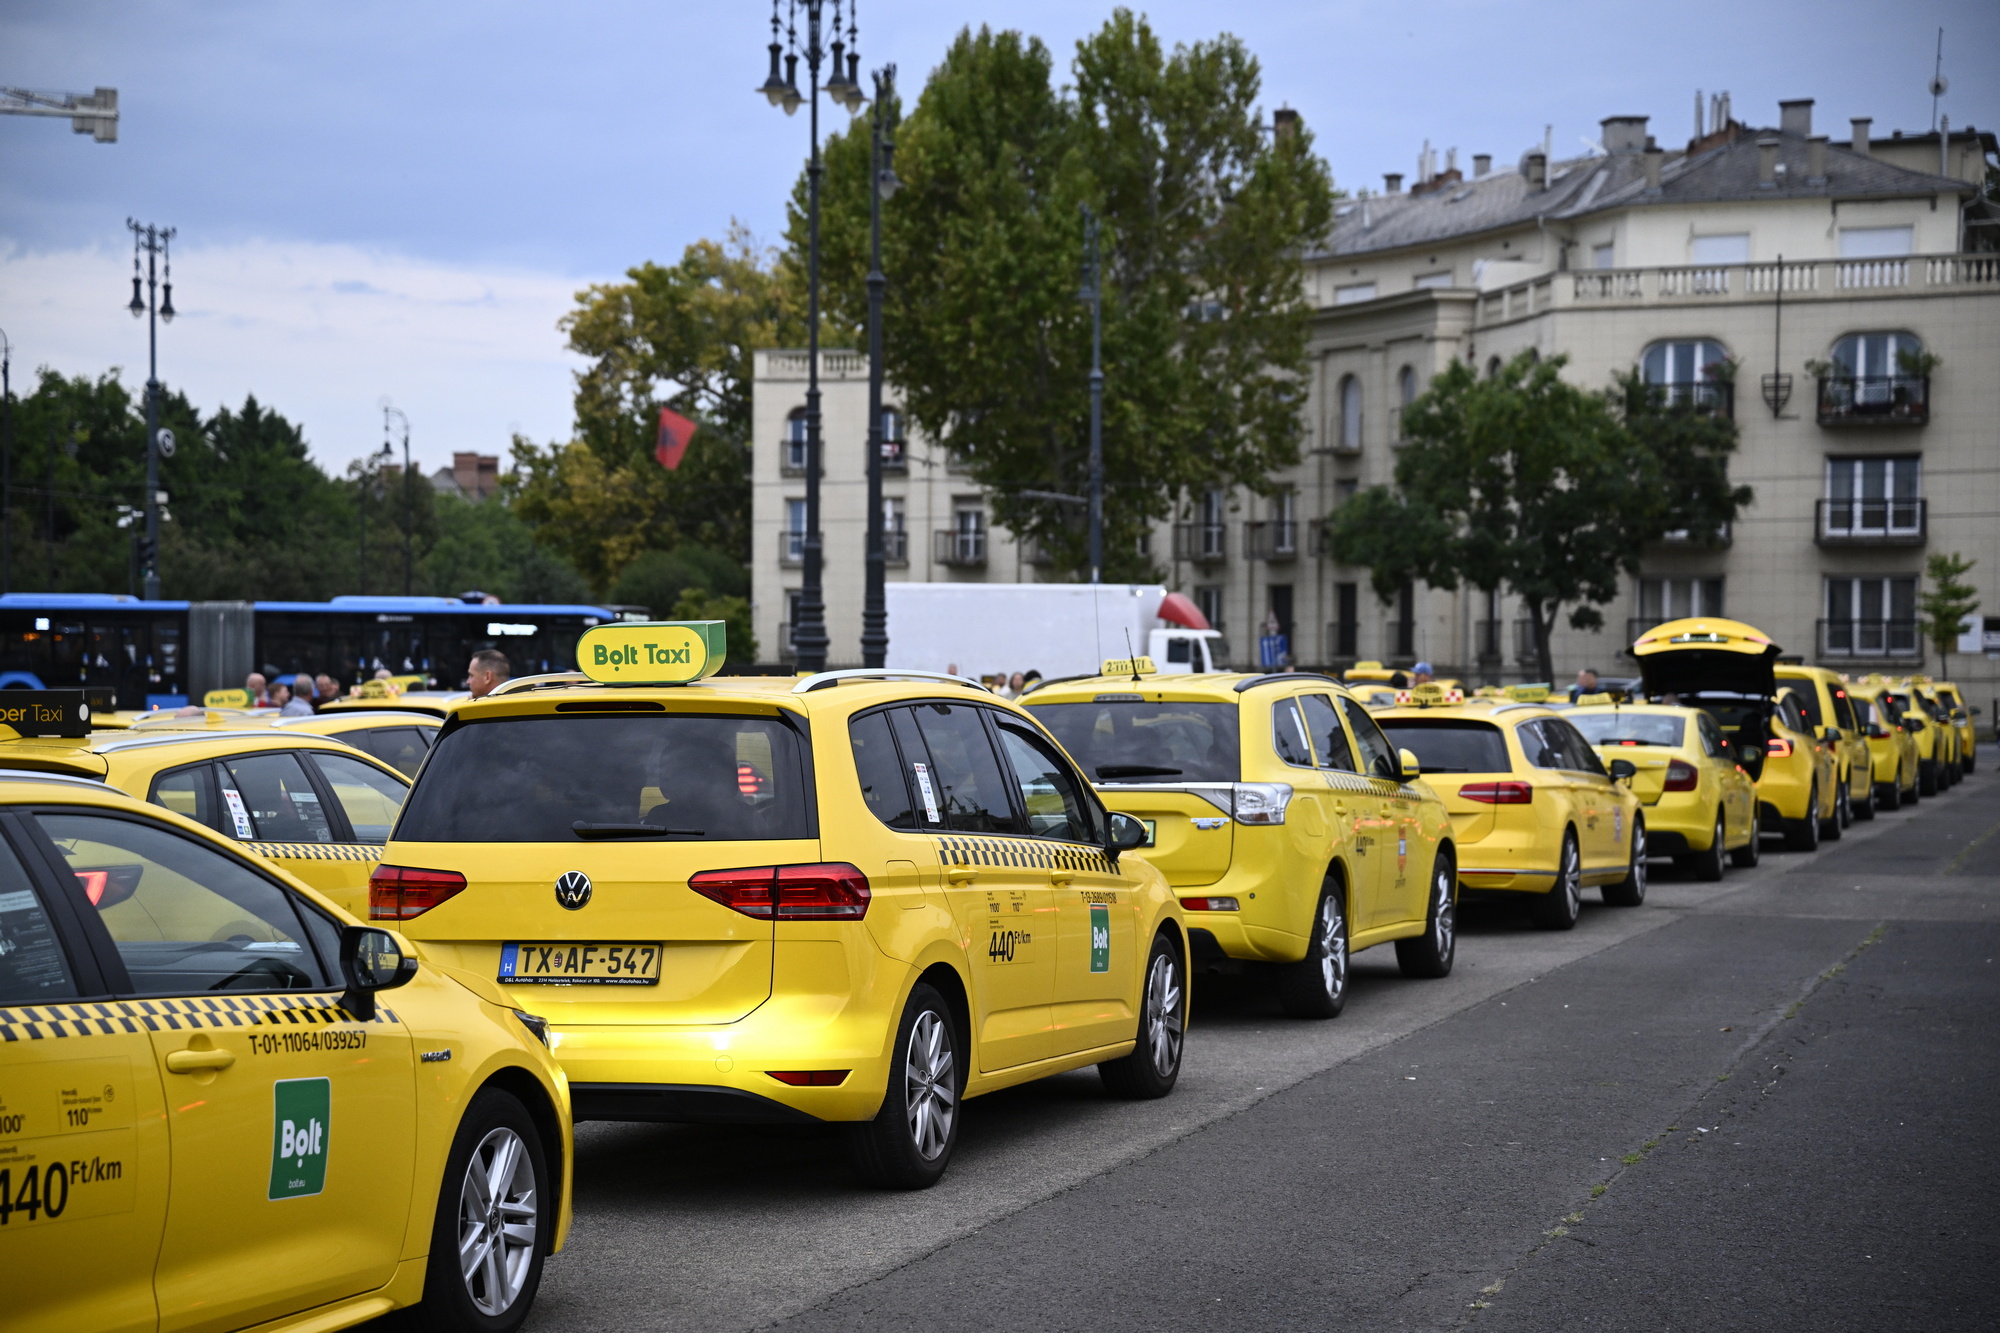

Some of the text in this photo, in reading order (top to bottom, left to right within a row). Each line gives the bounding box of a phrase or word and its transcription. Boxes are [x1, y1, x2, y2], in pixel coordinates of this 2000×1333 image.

[593, 641, 691, 672] Bolt Taxi
[1107, 659, 1145, 672] 2-111-11
[31, 703, 64, 722] Taxi
[989, 929, 1032, 963] 440 Ft/km
[1093, 926, 1108, 956] Bolt
[504, 963, 512, 972] H
[249, 1030, 367, 1054] T-01-11064/039257
[67, 1107, 88, 1126] 110
[281, 1117, 322, 1168] Bolt
[70, 1156, 121, 1185] Ft/km
